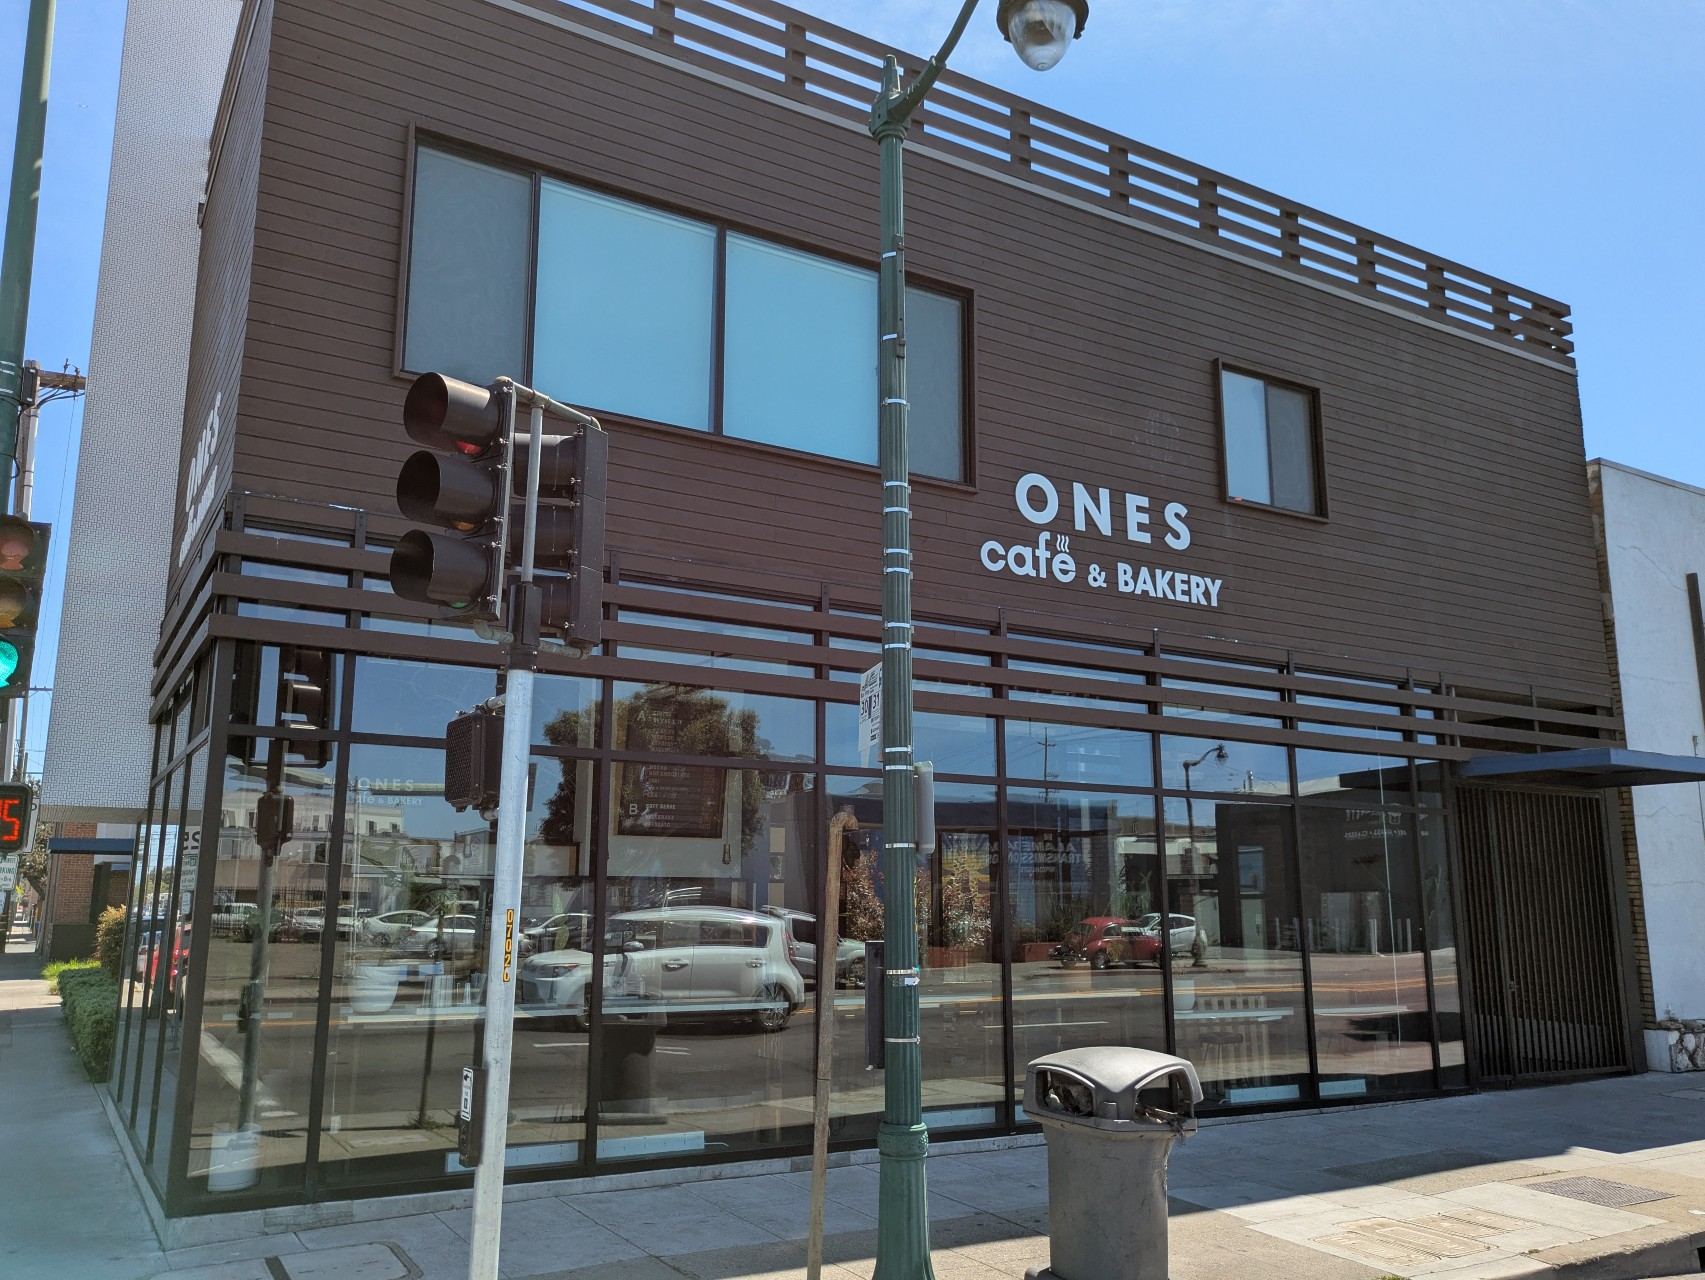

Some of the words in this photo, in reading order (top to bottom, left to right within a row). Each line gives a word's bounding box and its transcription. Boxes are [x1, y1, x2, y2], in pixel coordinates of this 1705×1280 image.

[1015, 473, 1191, 550] ONES
[1087, 563, 1107, 588] &
[1117, 562, 1223, 607] BAKERY
[357, 777, 414, 792] ONES
[387, 796, 424, 805] BAKERY
[629, 803, 638, 815] B
